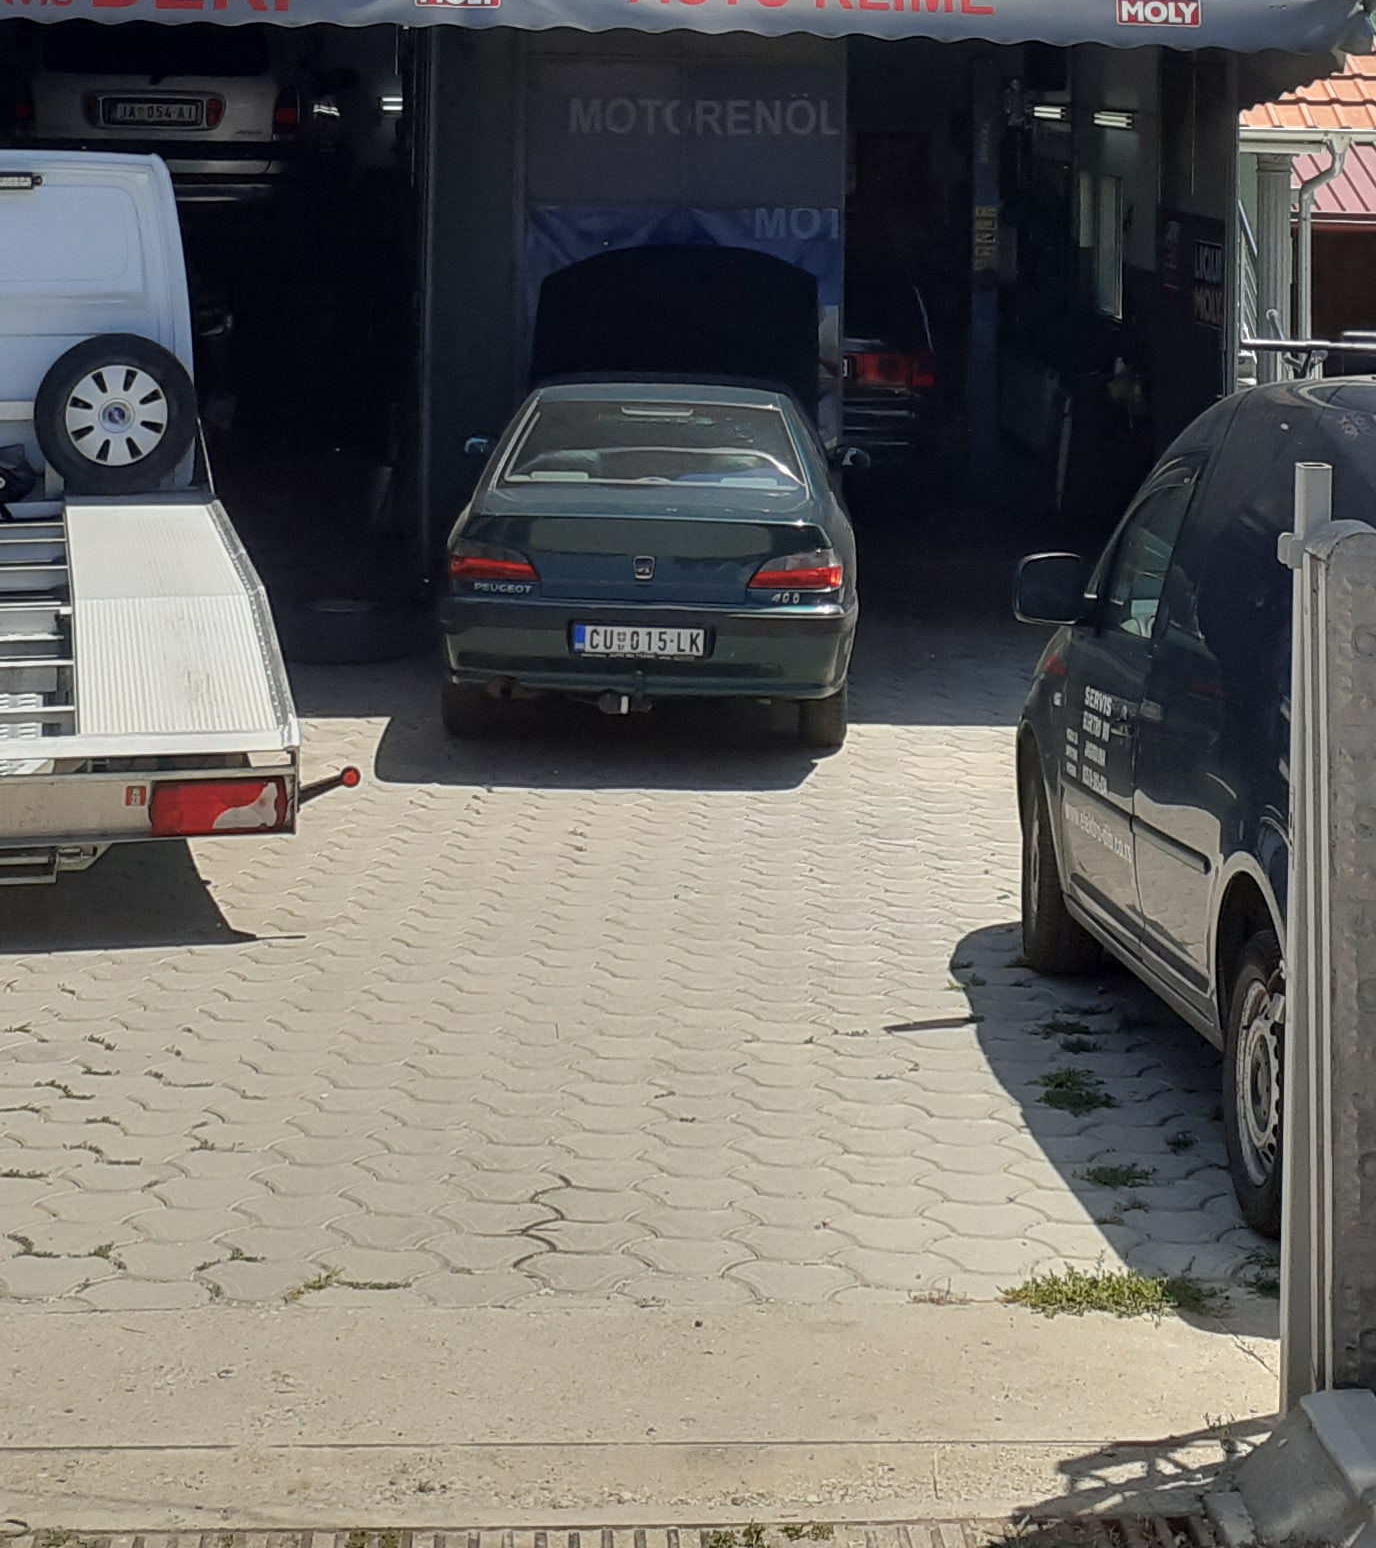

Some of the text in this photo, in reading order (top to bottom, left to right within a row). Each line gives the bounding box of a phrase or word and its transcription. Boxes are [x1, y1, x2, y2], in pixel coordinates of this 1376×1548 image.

[1118, 0, 1199, 26] MOLY
[569, 93, 841, 136] MOTORENÖL
[474, 582, 532, 594] PEUGEOT
[1084, 686, 1112, 717] SERVIS
